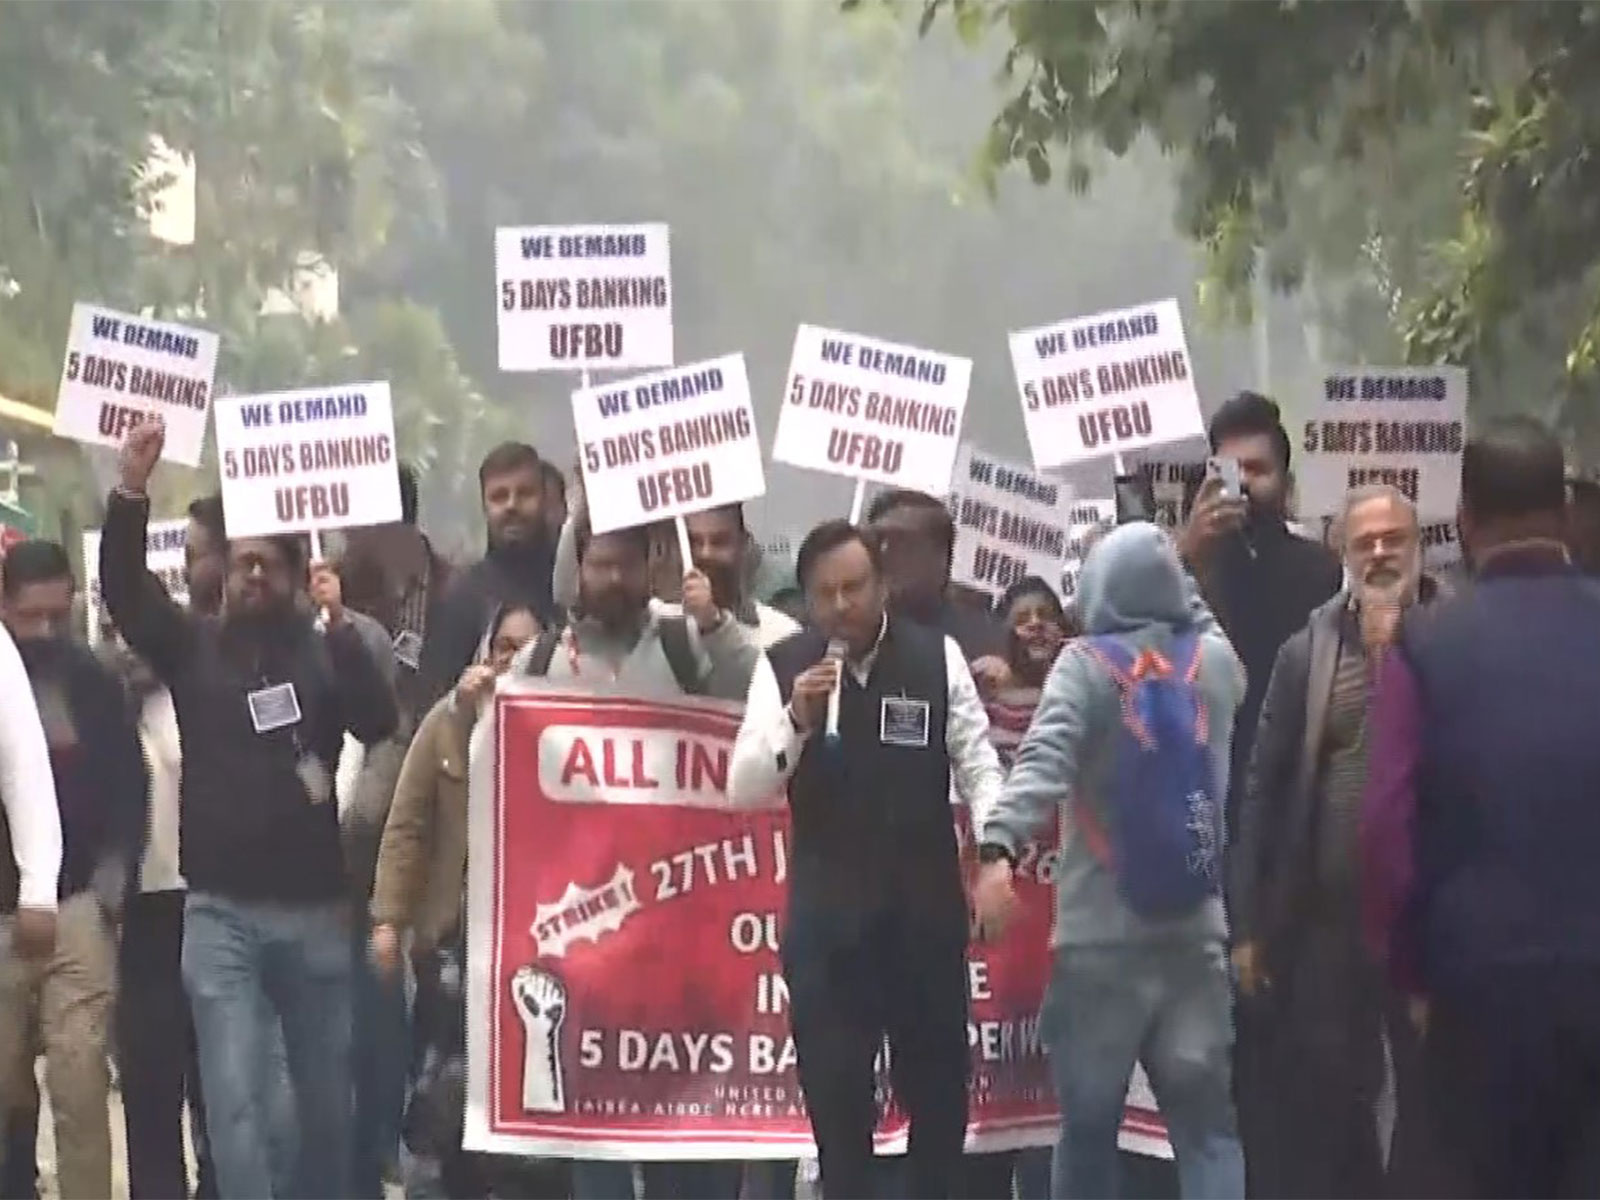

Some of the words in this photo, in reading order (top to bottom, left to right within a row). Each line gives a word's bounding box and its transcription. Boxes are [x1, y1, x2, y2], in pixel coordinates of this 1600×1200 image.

[521, 236, 553, 258] WE
[558, 234, 646, 257] DEMAND
[502, 279, 515, 311] 5
[520, 278, 571, 310] DAYS
[577, 276, 667, 309] BANKING
[92, 314, 121, 341] WE
[123, 323, 199, 359] DEMAND
[549, 322, 623, 359] UFBU
[1035, 331, 1067, 359] WE
[1072, 313, 1158, 351] DEMAND
[67, 352, 80, 381] 5
[82, 355, 127, 391] DAYS
[129, 365, 208, 410] BANKING
[821, 339, 853, 365] WE
[858, 346, 947, 385] DEMAND
[1023, 380, 1040, 412] 5
[1042, 368, 1095, 408] DAYS
[1097, 351, 1187, 395] BANKING
[241, 403, 273, 427] WE
[279, 393, 367, 423] DEMAND
[597, 390, 631, 419] WE
[636, 368, 724, 410] DEMAND
[790, 374, 806, 406] 5
[809, 380, 861, 417] DAYS
[865, 392, 956, 437] BANKING
[1324, 376, 1356, 401] WE
[1361, 376, 1447, 401] DEMAND
[98, 402, 164, 439] UFB
[584, 442, 600, 473] 5
[602, 430, 656, 469] DAYS
[659, 407, 750, 456] BANKING
[1078, 401, 1152, 448] UFBU
[1304, 420, 1319, 453] 5
[1322, 420, 1372, 453] DAYS
[1375, 421, 1463, 454] BANKING
[224, 449, 239, 479] 5
[243, 443, 295, 478] DAYS
[300, 433, 391, 471] BANKING
[827, 427, 904, 474] UFBU
[274, 482, 350, 522] UFBU
[637, 461, 713, 512] UFBU
[969, 457, 993, 485] WE
[995, 467, 1057, 506] DEMAND
[960, 496, 999, 537] DAYS
[999, 510, 1064, 560] BANKING
[973, 546, 1027, 588] UFBU
[561, 737, 659, 788] ALL
[651, 836, 757, 900] 27TH
[581, 1029, 603, 1068] 5
[619, 1029, 734, 1074] DAYS
